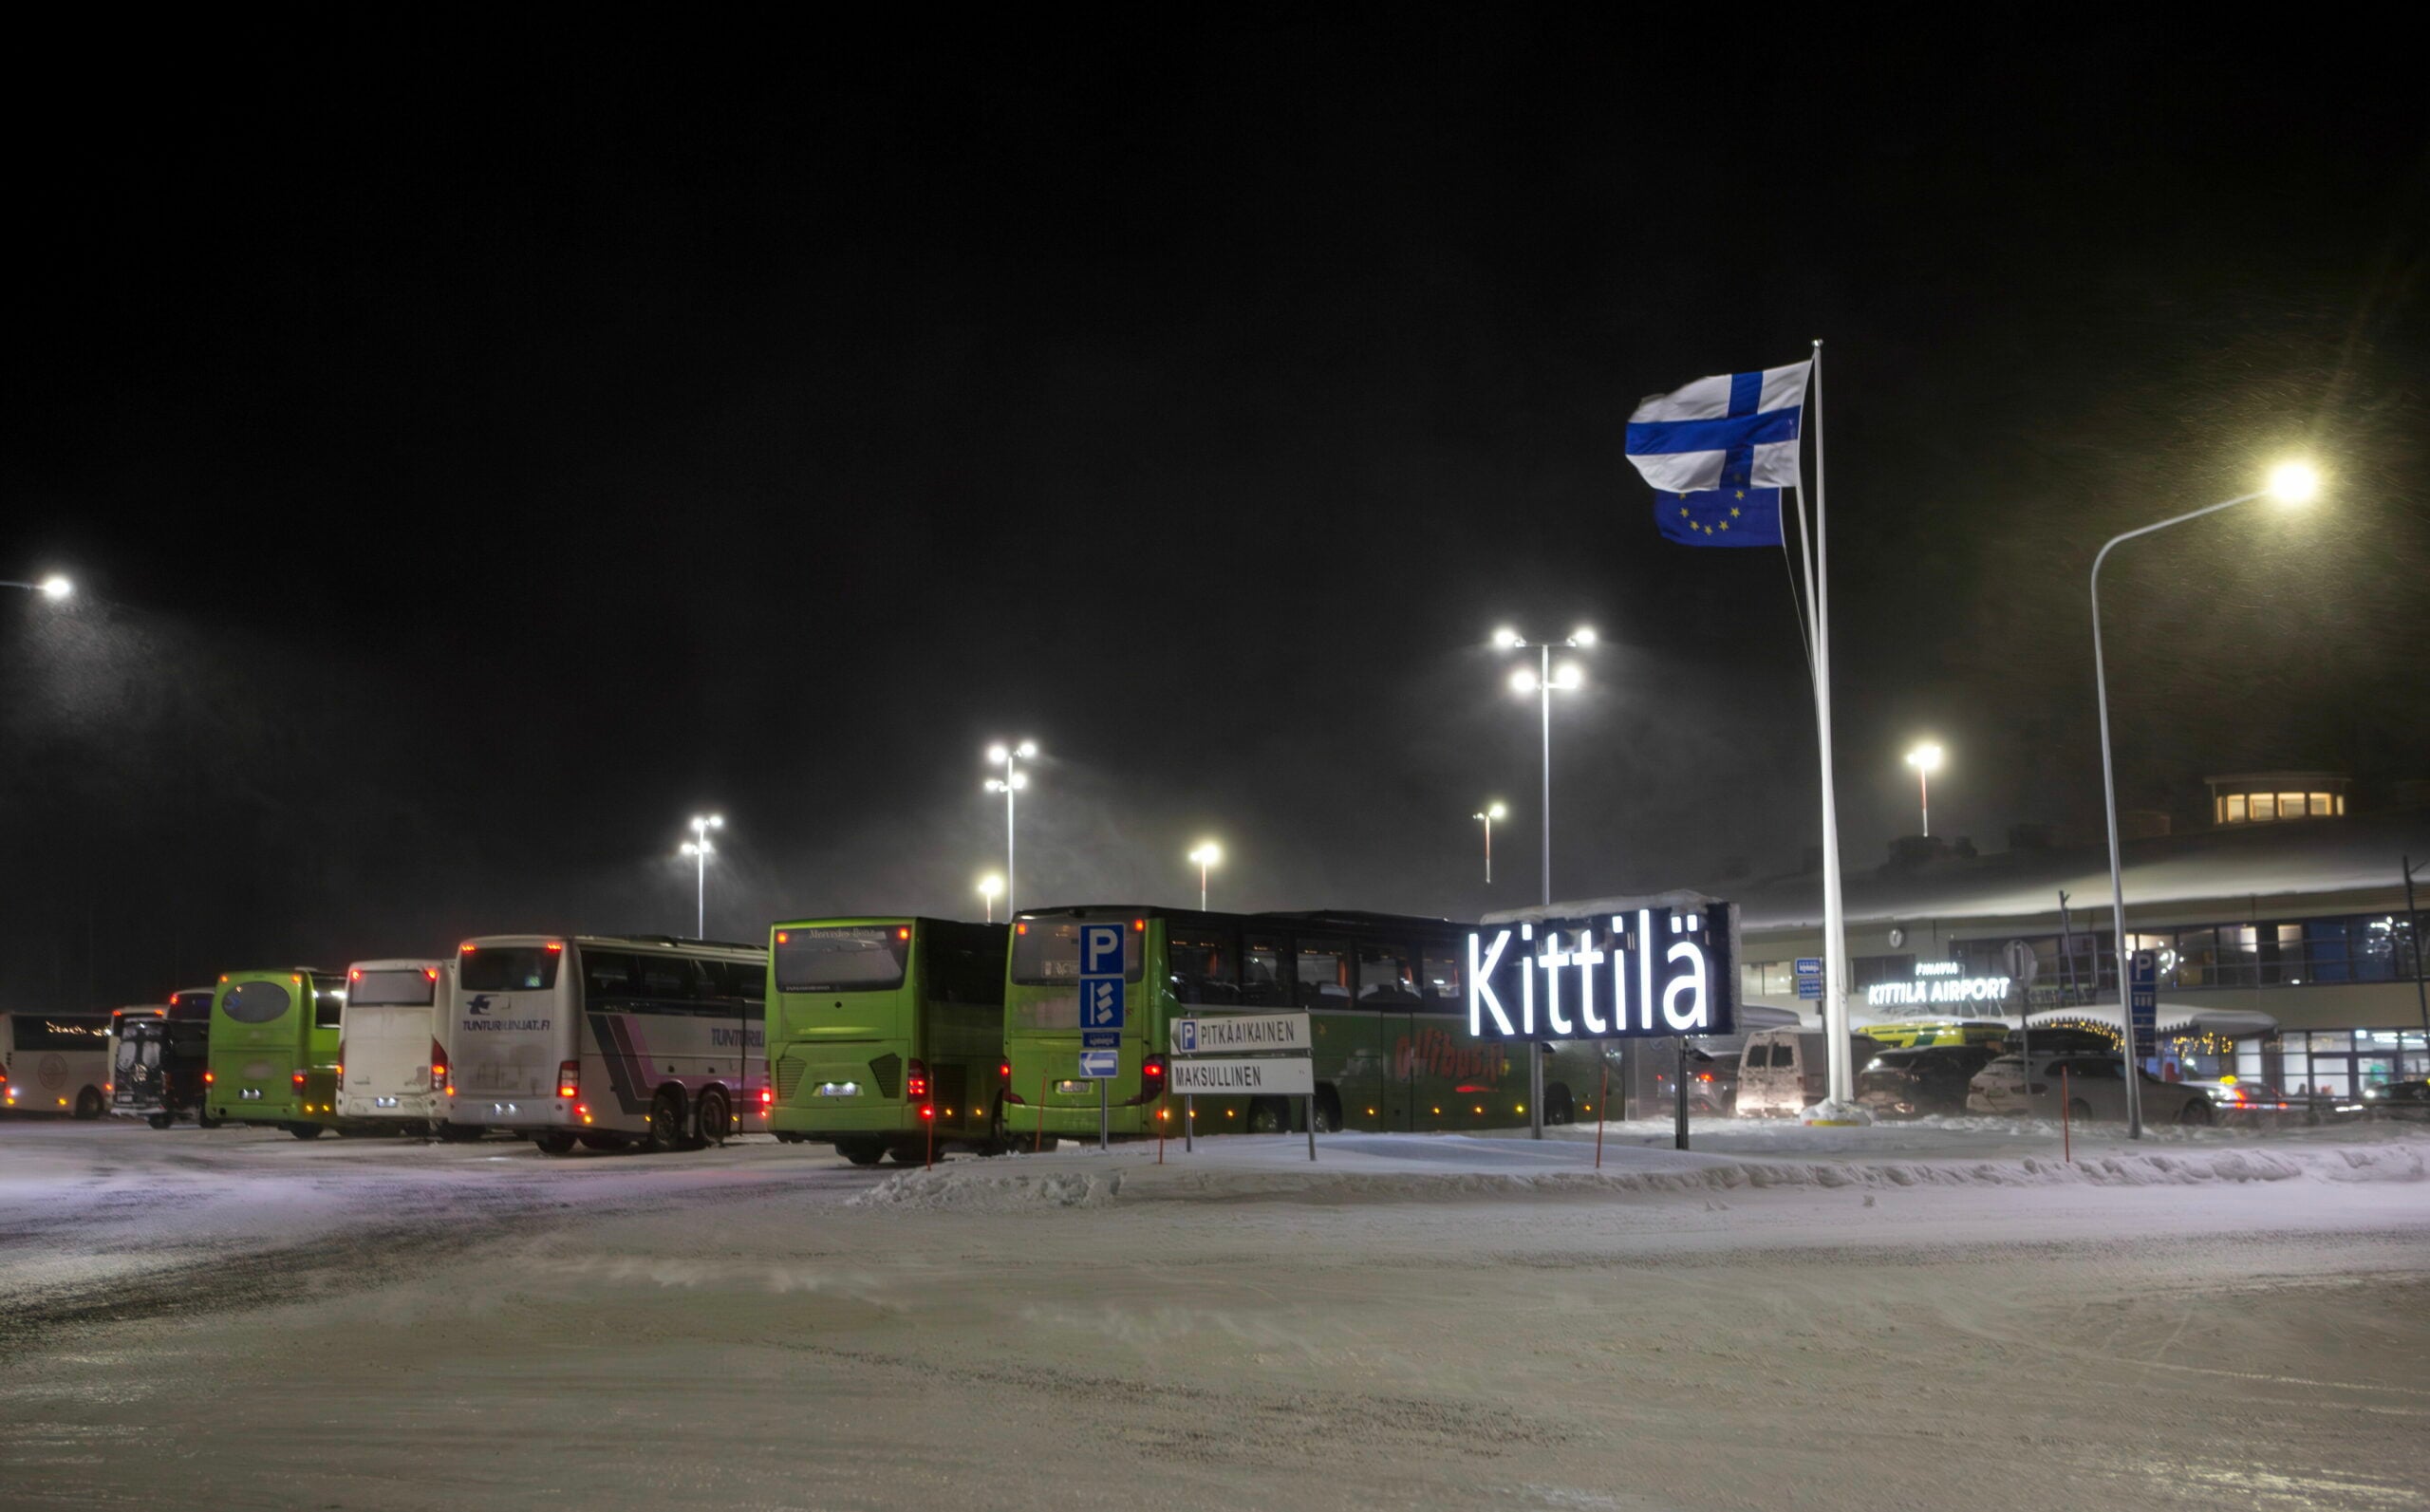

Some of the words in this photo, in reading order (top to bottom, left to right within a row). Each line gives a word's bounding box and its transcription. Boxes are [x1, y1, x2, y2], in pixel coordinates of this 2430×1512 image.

[1089, 928, 1118, 971] P
[1468, 908, 1709, 1037] Kittilä
[2136, 954, 2152, 980] P
[1868, 981, 1927, 1005] KITTILÄ
[1930, 978, 2010, 1002] AIRPORT
[1201, 1020, 1295, 1044] PITKÄAIKAINEN
[1175, 1066, 1262, 1088] MAKSULLINEN
